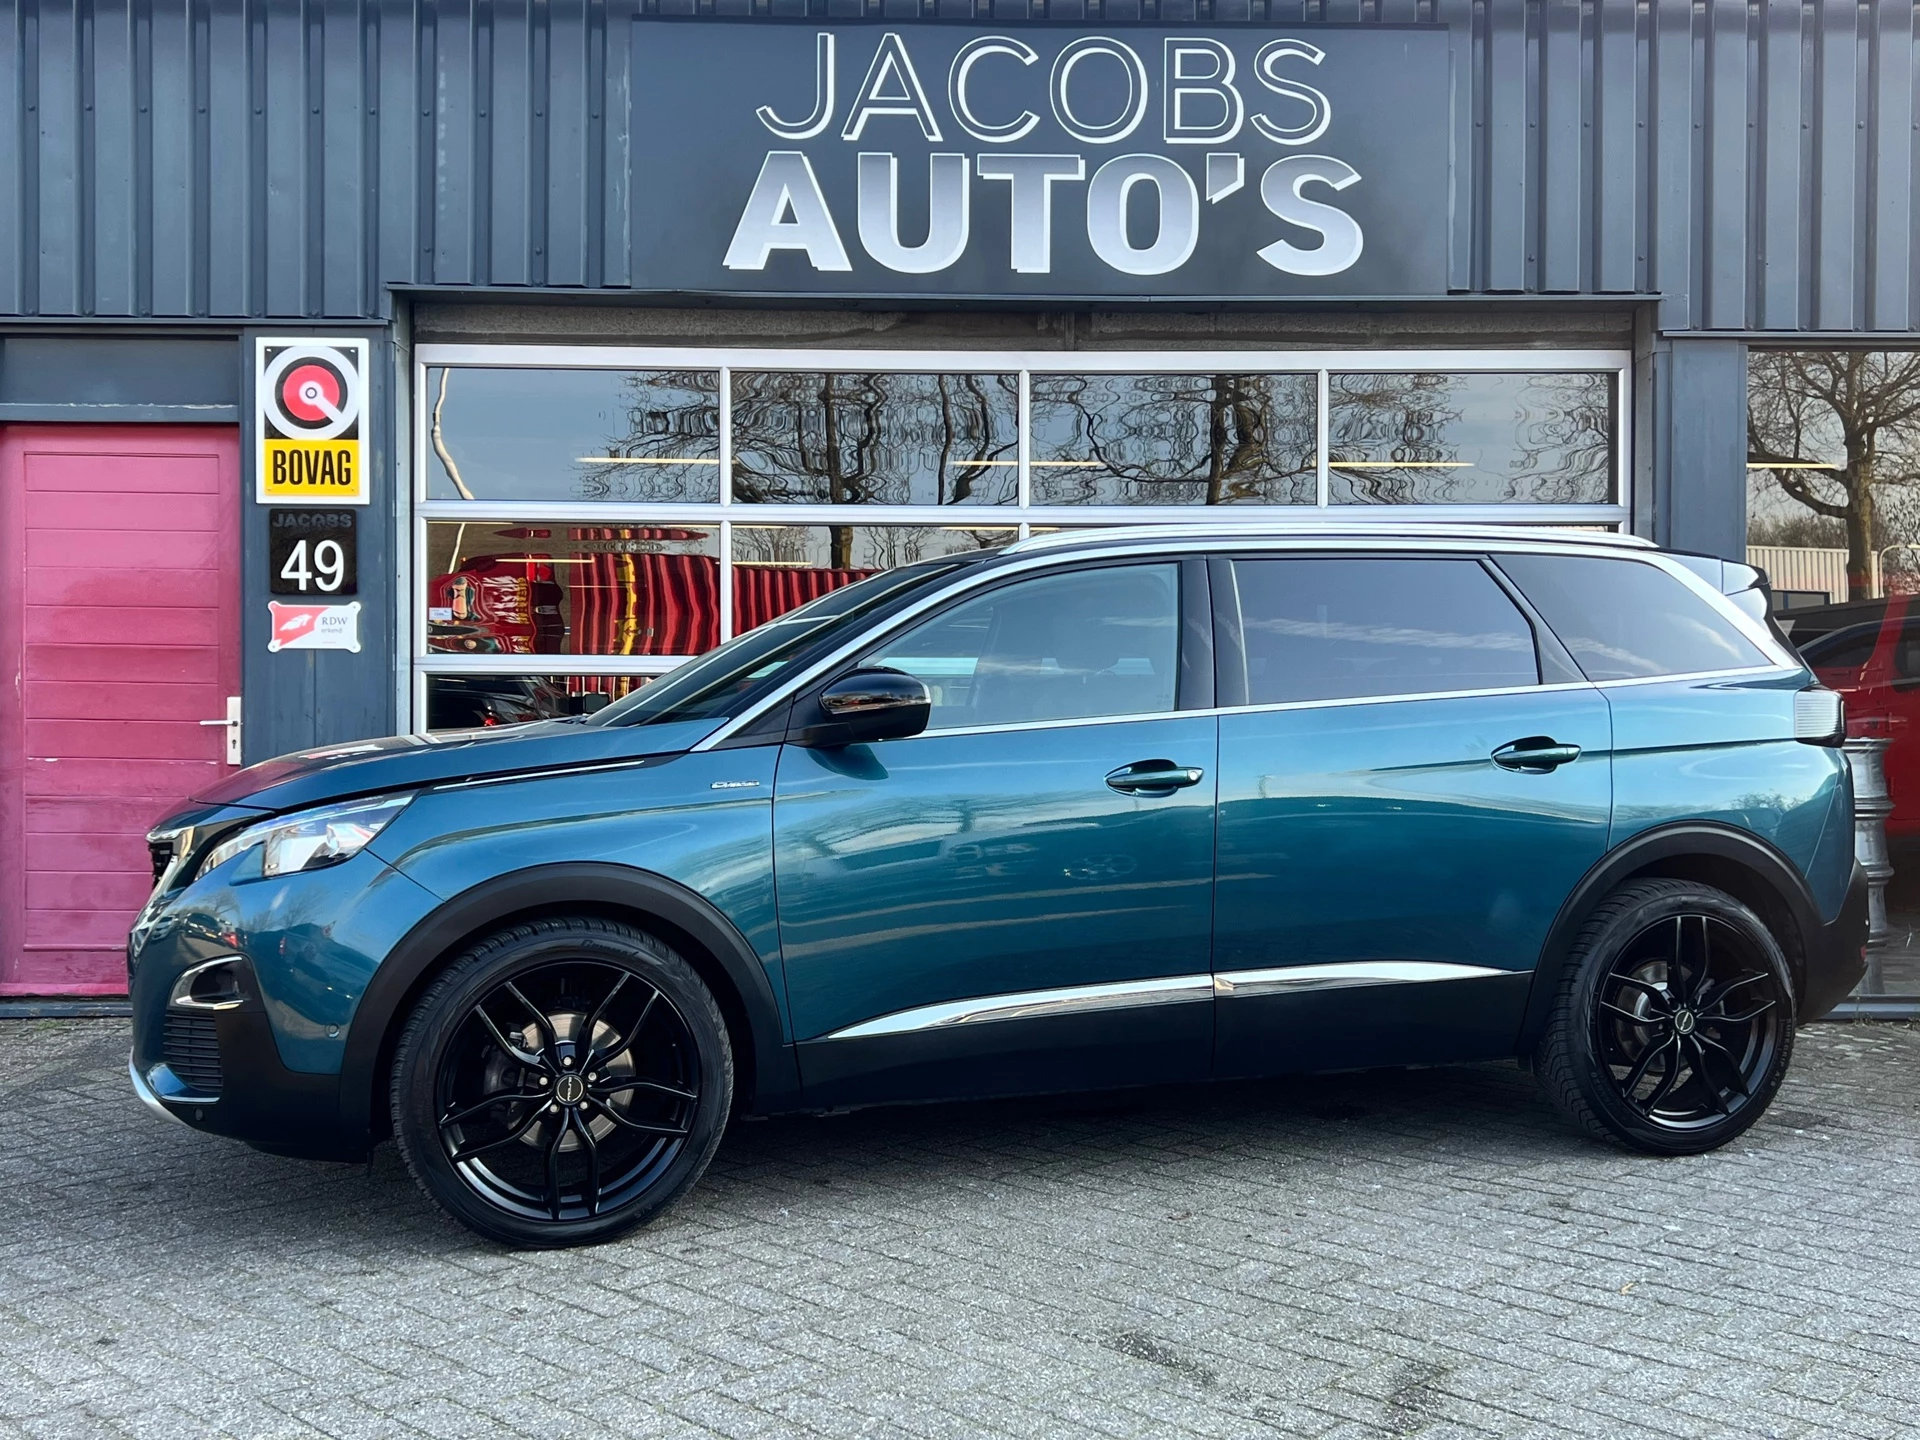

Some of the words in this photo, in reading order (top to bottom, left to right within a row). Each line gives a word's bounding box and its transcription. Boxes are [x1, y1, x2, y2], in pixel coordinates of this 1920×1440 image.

[756, 32, 1331, 145] JACOBS
[722, 150, 1364, 276] AUTO'S
[272, 449, 352, 486] BOVAG
[272, 512, 352, 528] JACOBS
[280, 539, 344, 592] 49
[321, 616, 348, 626] RDW
